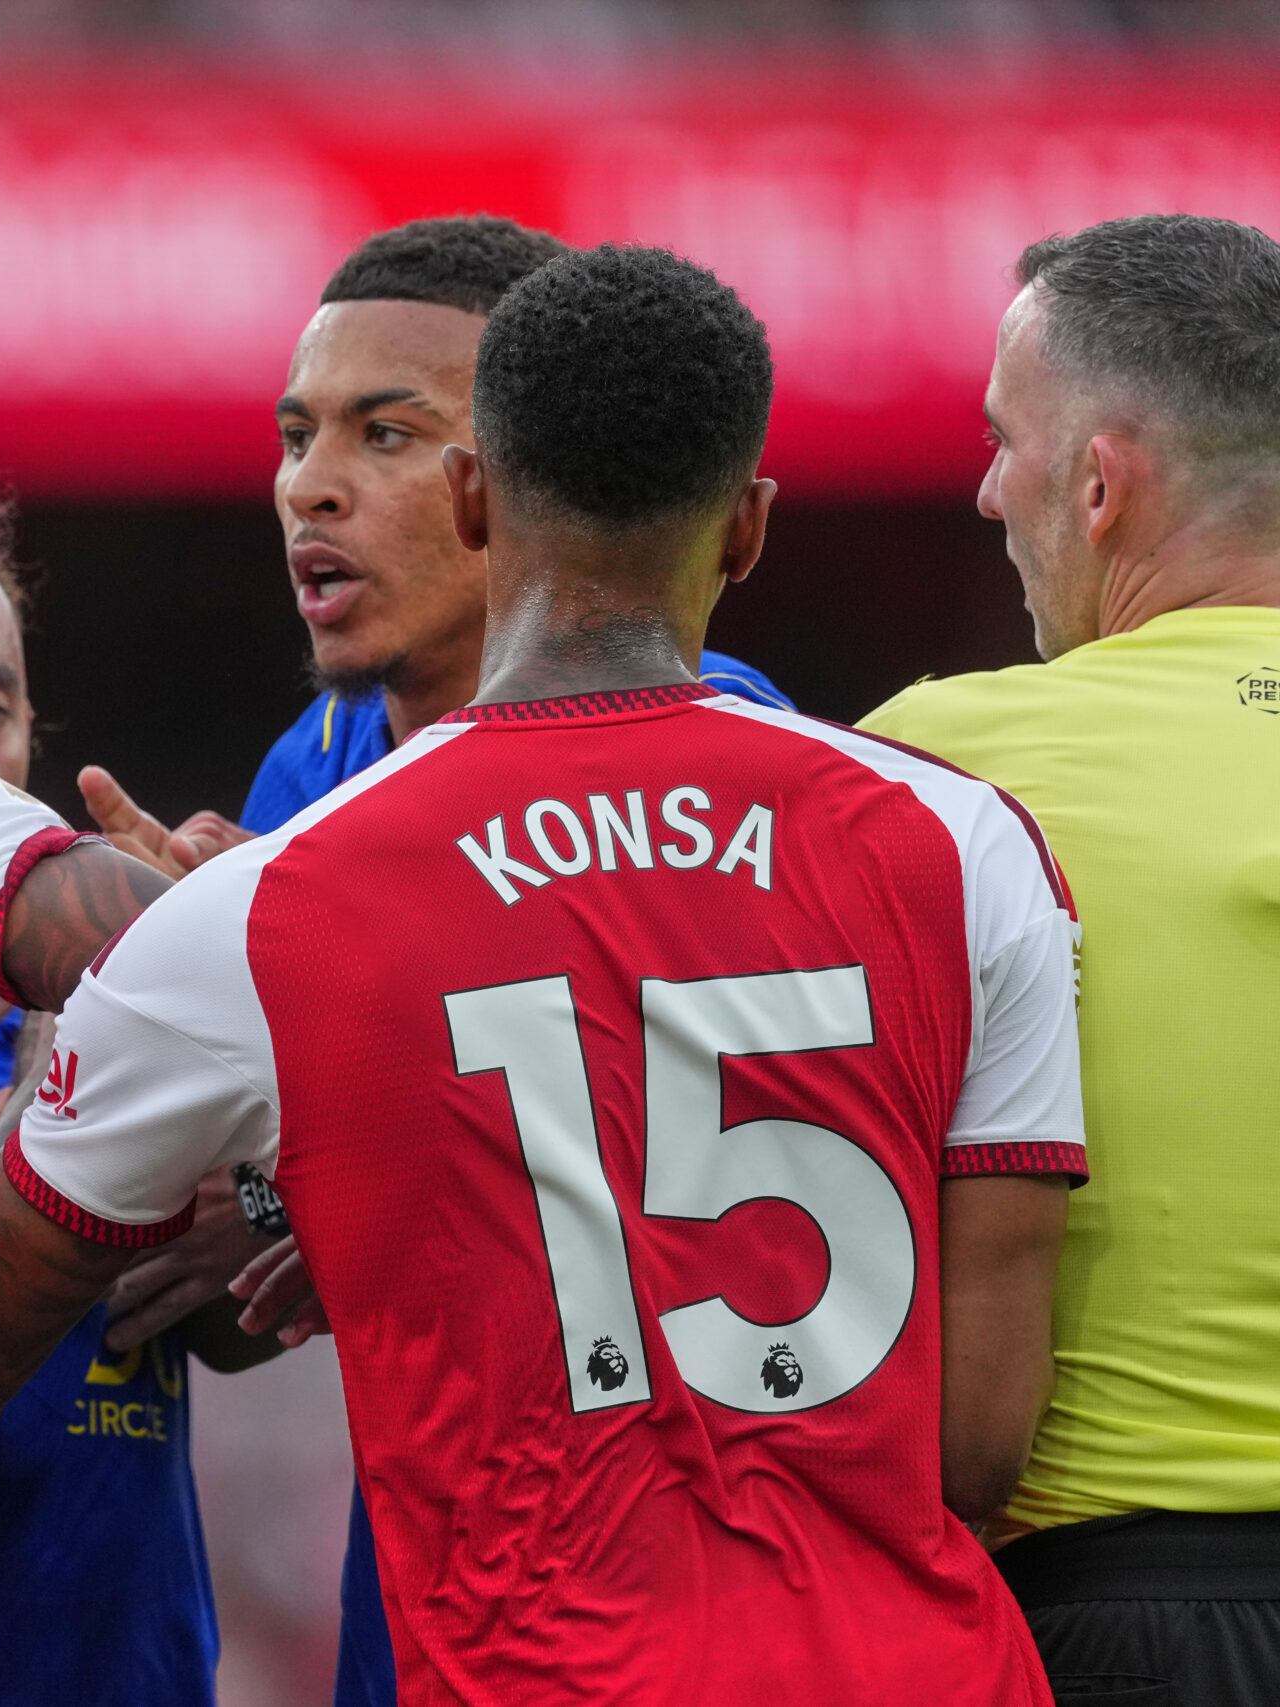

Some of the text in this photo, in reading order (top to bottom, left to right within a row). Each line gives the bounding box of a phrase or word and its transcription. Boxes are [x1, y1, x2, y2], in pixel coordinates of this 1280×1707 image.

[1248, 690, 1280, 701] RE
[1249, 679, 1280, 690] PR
[453, 784, 776, 908] KONSA
[440, 962, 918, 1416] 15
[66, 1399, 167, 1441] IRCE
